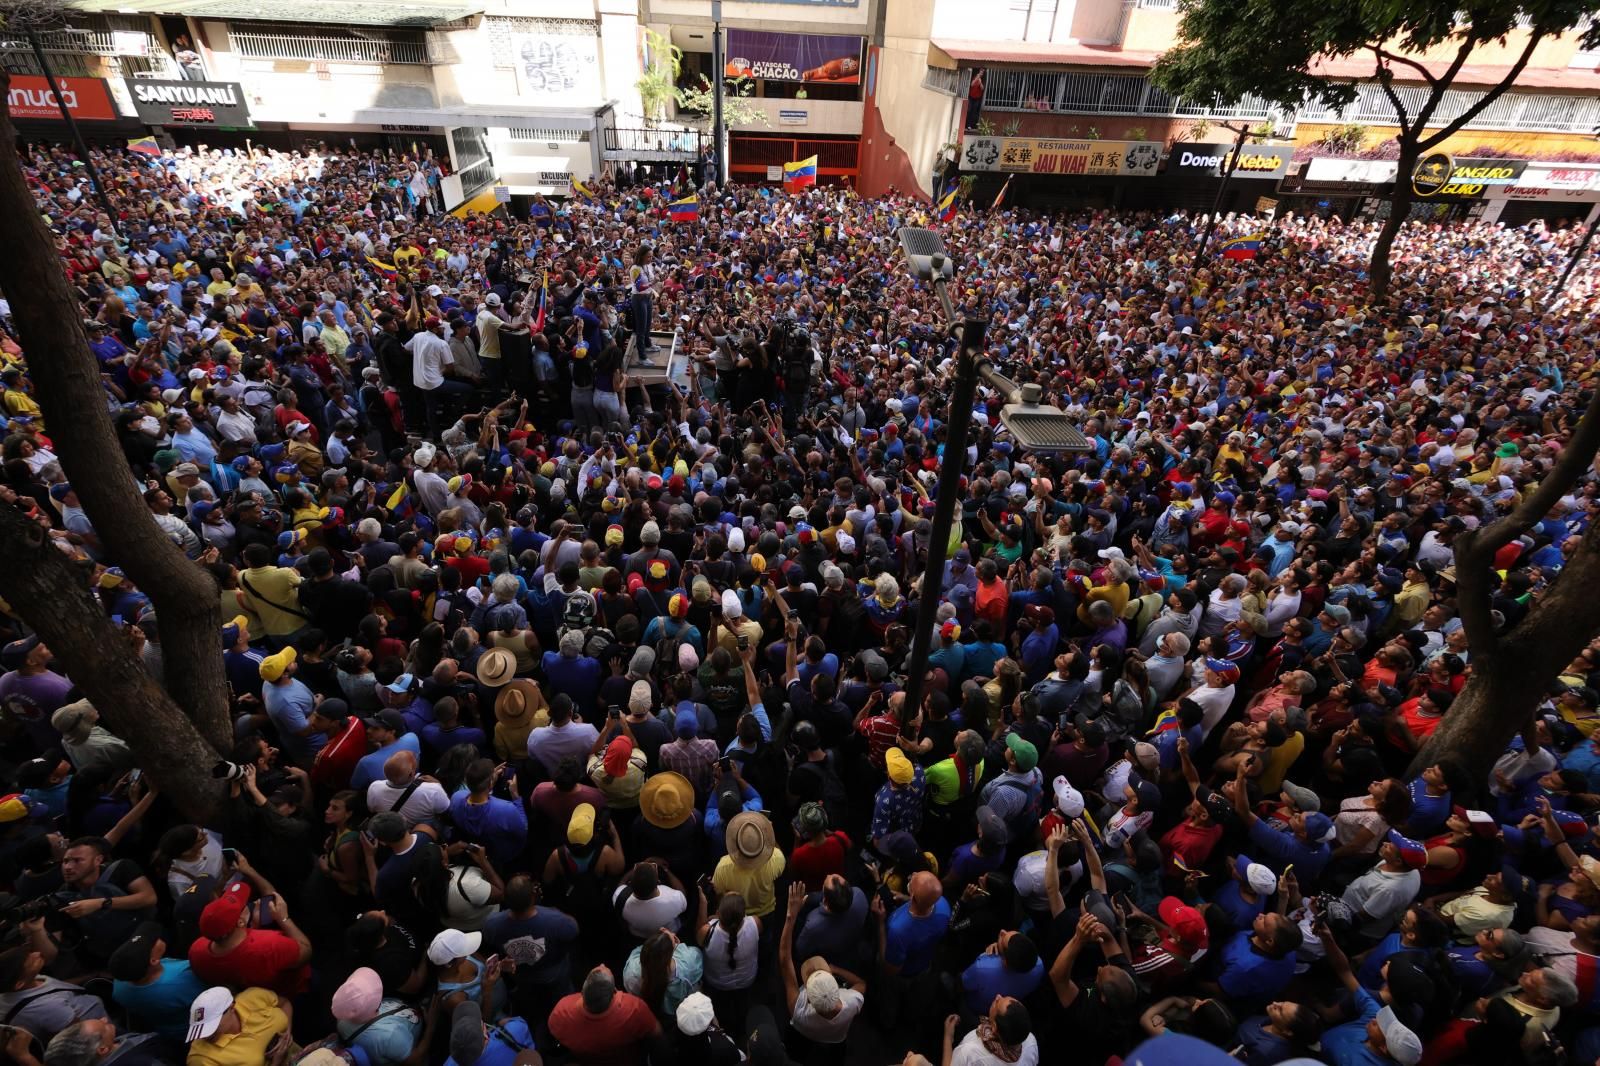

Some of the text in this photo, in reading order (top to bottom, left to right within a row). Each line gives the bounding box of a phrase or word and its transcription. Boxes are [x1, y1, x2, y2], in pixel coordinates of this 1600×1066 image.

[752, 67, 798, 79] CHACAO
[1037, 142, 1091, 151] RESTAURANT
[1033, 153, 1088, 174] JAU WAH
[1090, 152, 1121, 168] 酒家
[1180, 152, 1281, 169] Doner Kebab
